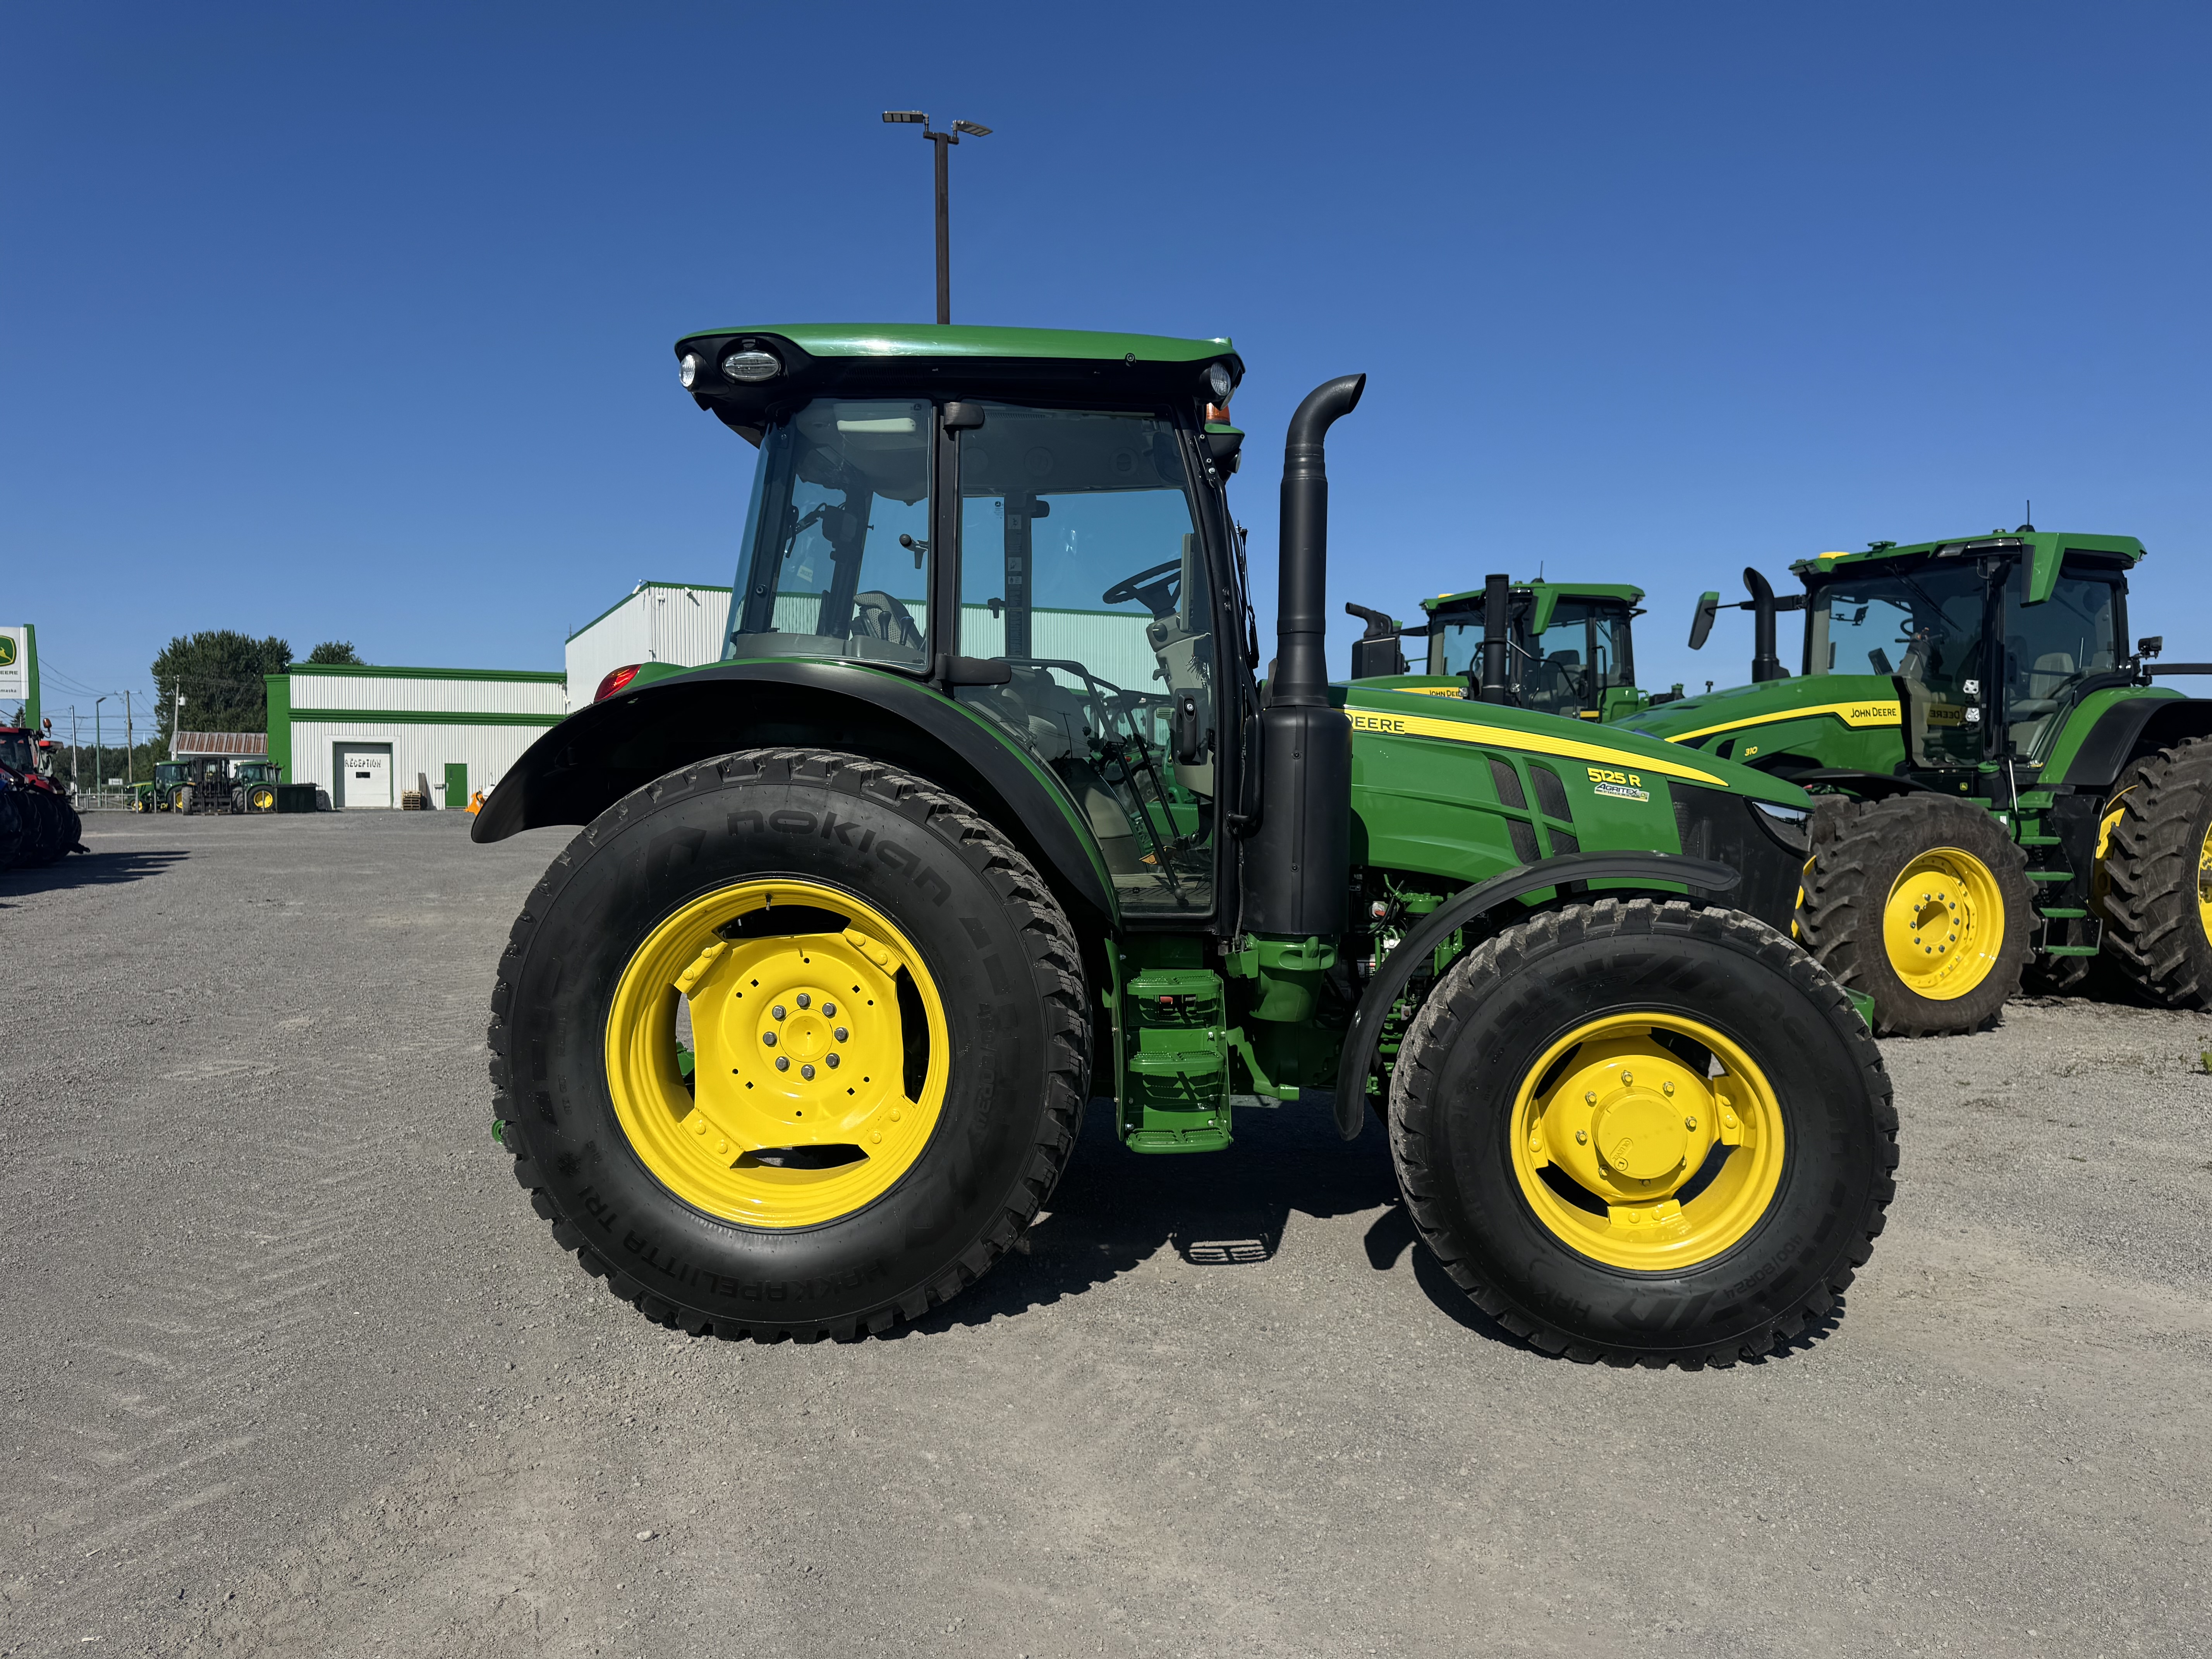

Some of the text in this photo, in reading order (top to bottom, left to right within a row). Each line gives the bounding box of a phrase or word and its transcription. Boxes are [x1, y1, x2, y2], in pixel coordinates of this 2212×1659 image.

[1851, 707, 1897, 718] JOHN DEERE
[1744, 746, 1758, 757] 310
[1587, 767, 1642, 787] 5125 R
[1597, 783, 1638, 795] AGRITEX
[575, 1183, 623, 1234] TRI
